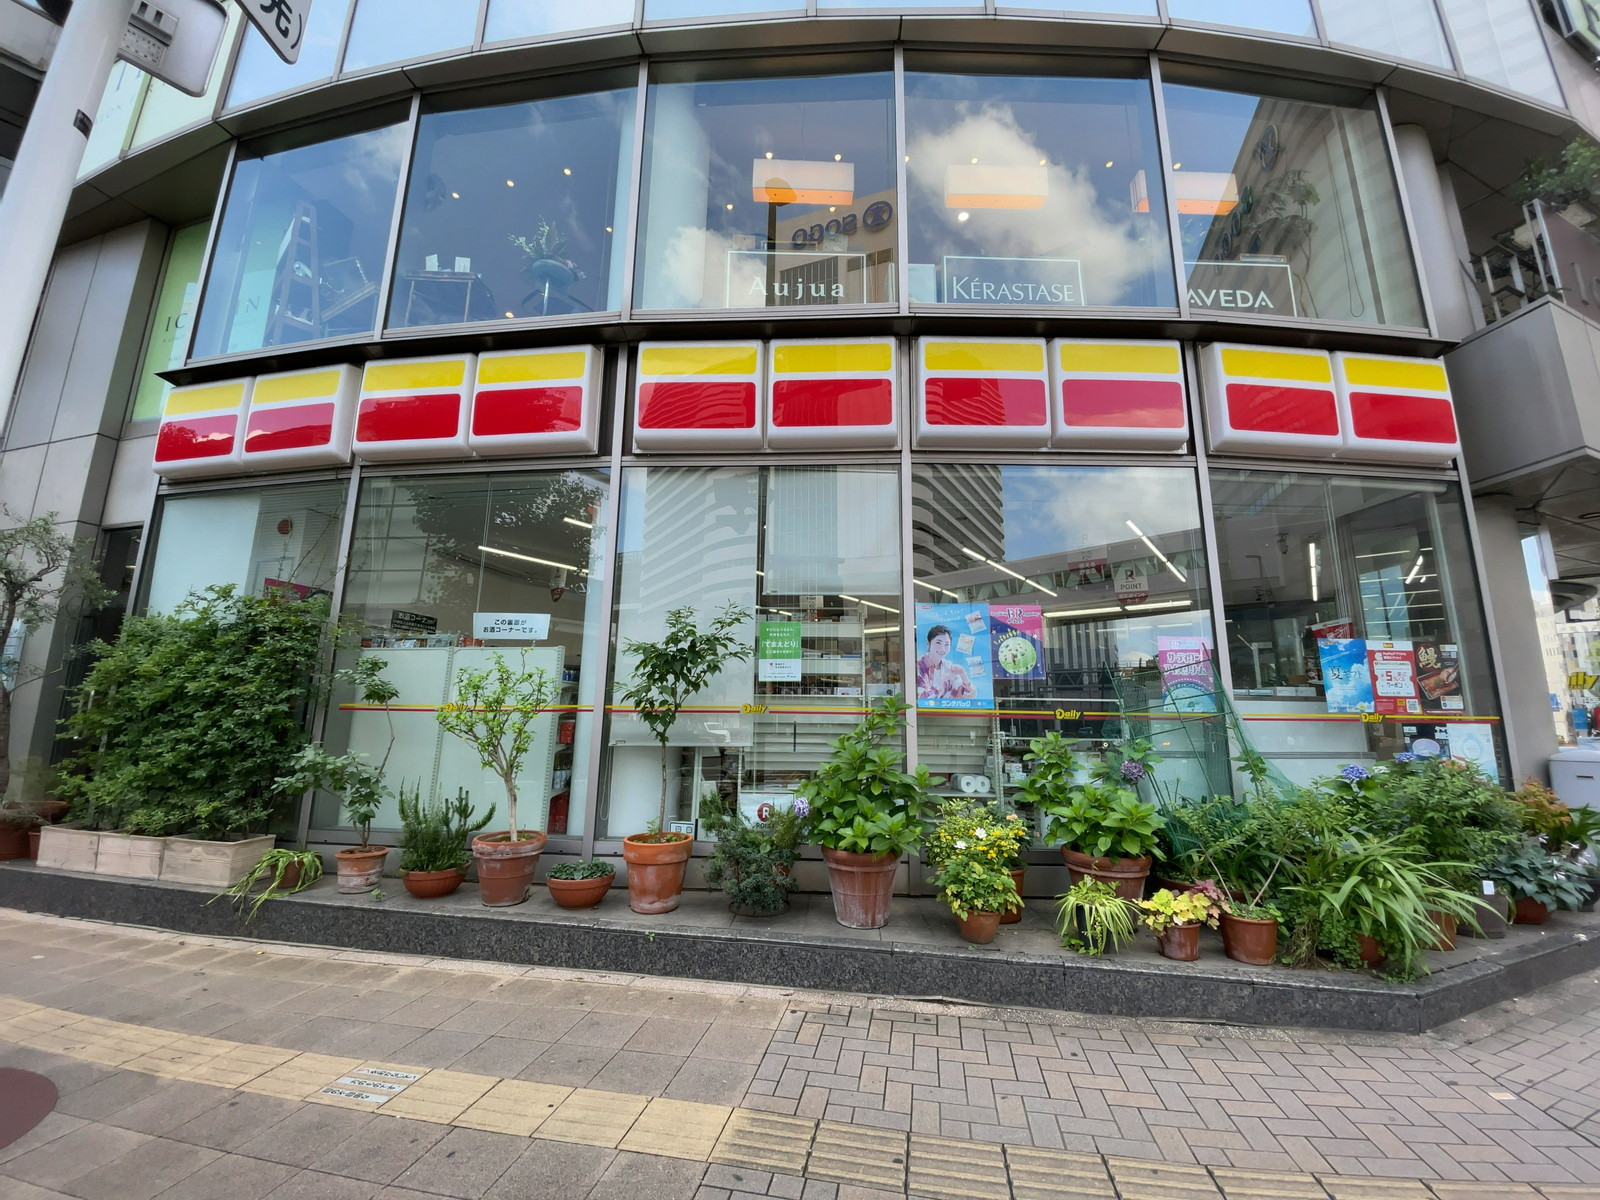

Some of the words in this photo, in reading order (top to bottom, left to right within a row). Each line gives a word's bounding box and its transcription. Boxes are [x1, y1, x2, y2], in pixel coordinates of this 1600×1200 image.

[748, 276, 845, 300] Aujua
[952, 276, 1075, 303] KÉRASTASE
[1187, 288, 1274, 308] AVEDA
[1120, 583, 1143, 591] POINT
[1418, 646, 1441, 669] 鰻
[1328, 665, 1362, 681] 夏ギフト
[741, 703, 768, 714] Daily
[1055, 708, 1082, 720] Daily
[1361, 712, 1384, 723] Daily
